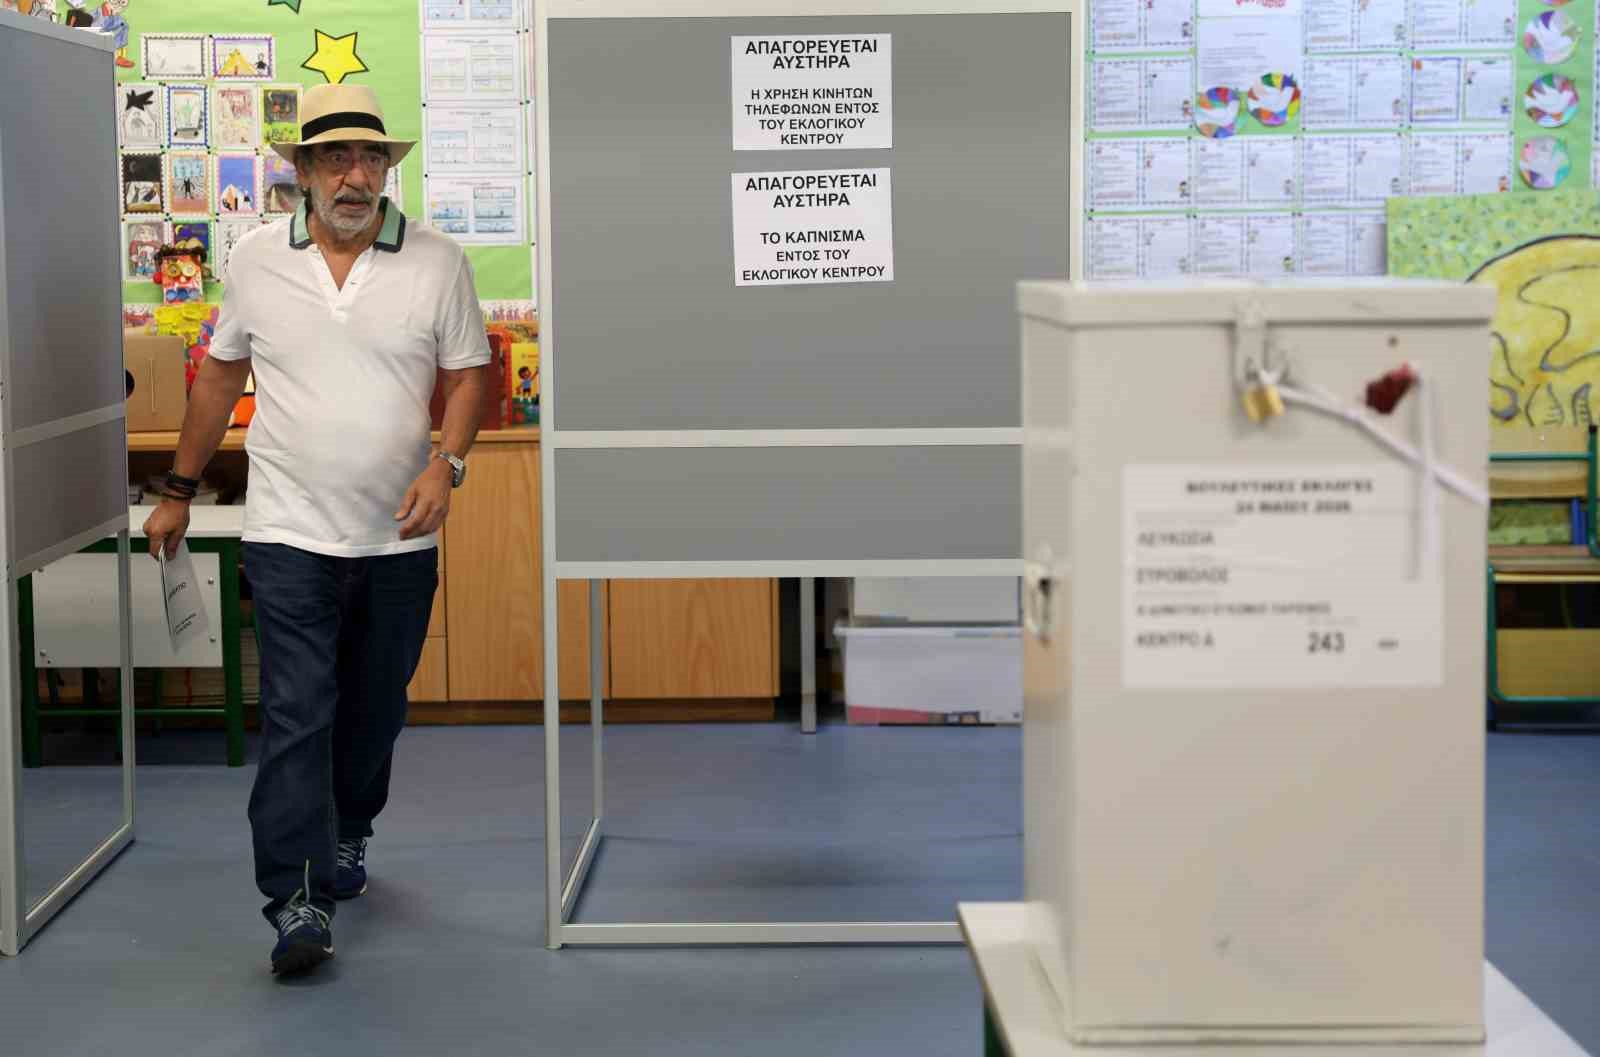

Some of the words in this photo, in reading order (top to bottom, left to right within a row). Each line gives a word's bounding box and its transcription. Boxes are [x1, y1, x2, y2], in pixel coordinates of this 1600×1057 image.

[745, 40, 877, 54] ΑΠΑΓΟΡΕΥΕΤΑΙ
[773, 56, 850, 69] ΑΥΣΤΗΡΑ
[751, 89, 760, 99] Η
[765, 89, 808, 99] ΧΡΗΣΗ
[813, 88, 872, 98] ΚΙΝΗΤΩΝ
[745, 104, 830, 115] ΤΗΛΕΦΩΝΩΝ
[836, 103, 880, 114] ΕΝΤΟΣ
[759, 119, 784, 130] ΤΟΥ
[790, 118, 865, 129] ΕΚΛΟΓΙΚΟΥ
[781, 134, 844, 145] ΚΕΝΤΡΟΥ
[746, 174, 876, 190] ΑΠΑΓΟΡΕΥΕΤΑΙ
[773, 194, 849, 208] ΑΥΣΤΗΡΑ
[760, 232, 781, 244] ΤΟ
[786, 230, 865, 243] ΚΑΠΝΙΣΜΑ
[777, 251, 820, 261] ΕΝΤΟΣ
[824, 250, 850, 260] ΤΟΥ
[743, 269, 818, 281] ΕΚΛΟΓΙΚΟΥ
[822, 267, 885, 278] ΚΕΝΤΡΟΥ
[1308, 632, 1345, 653] 243
